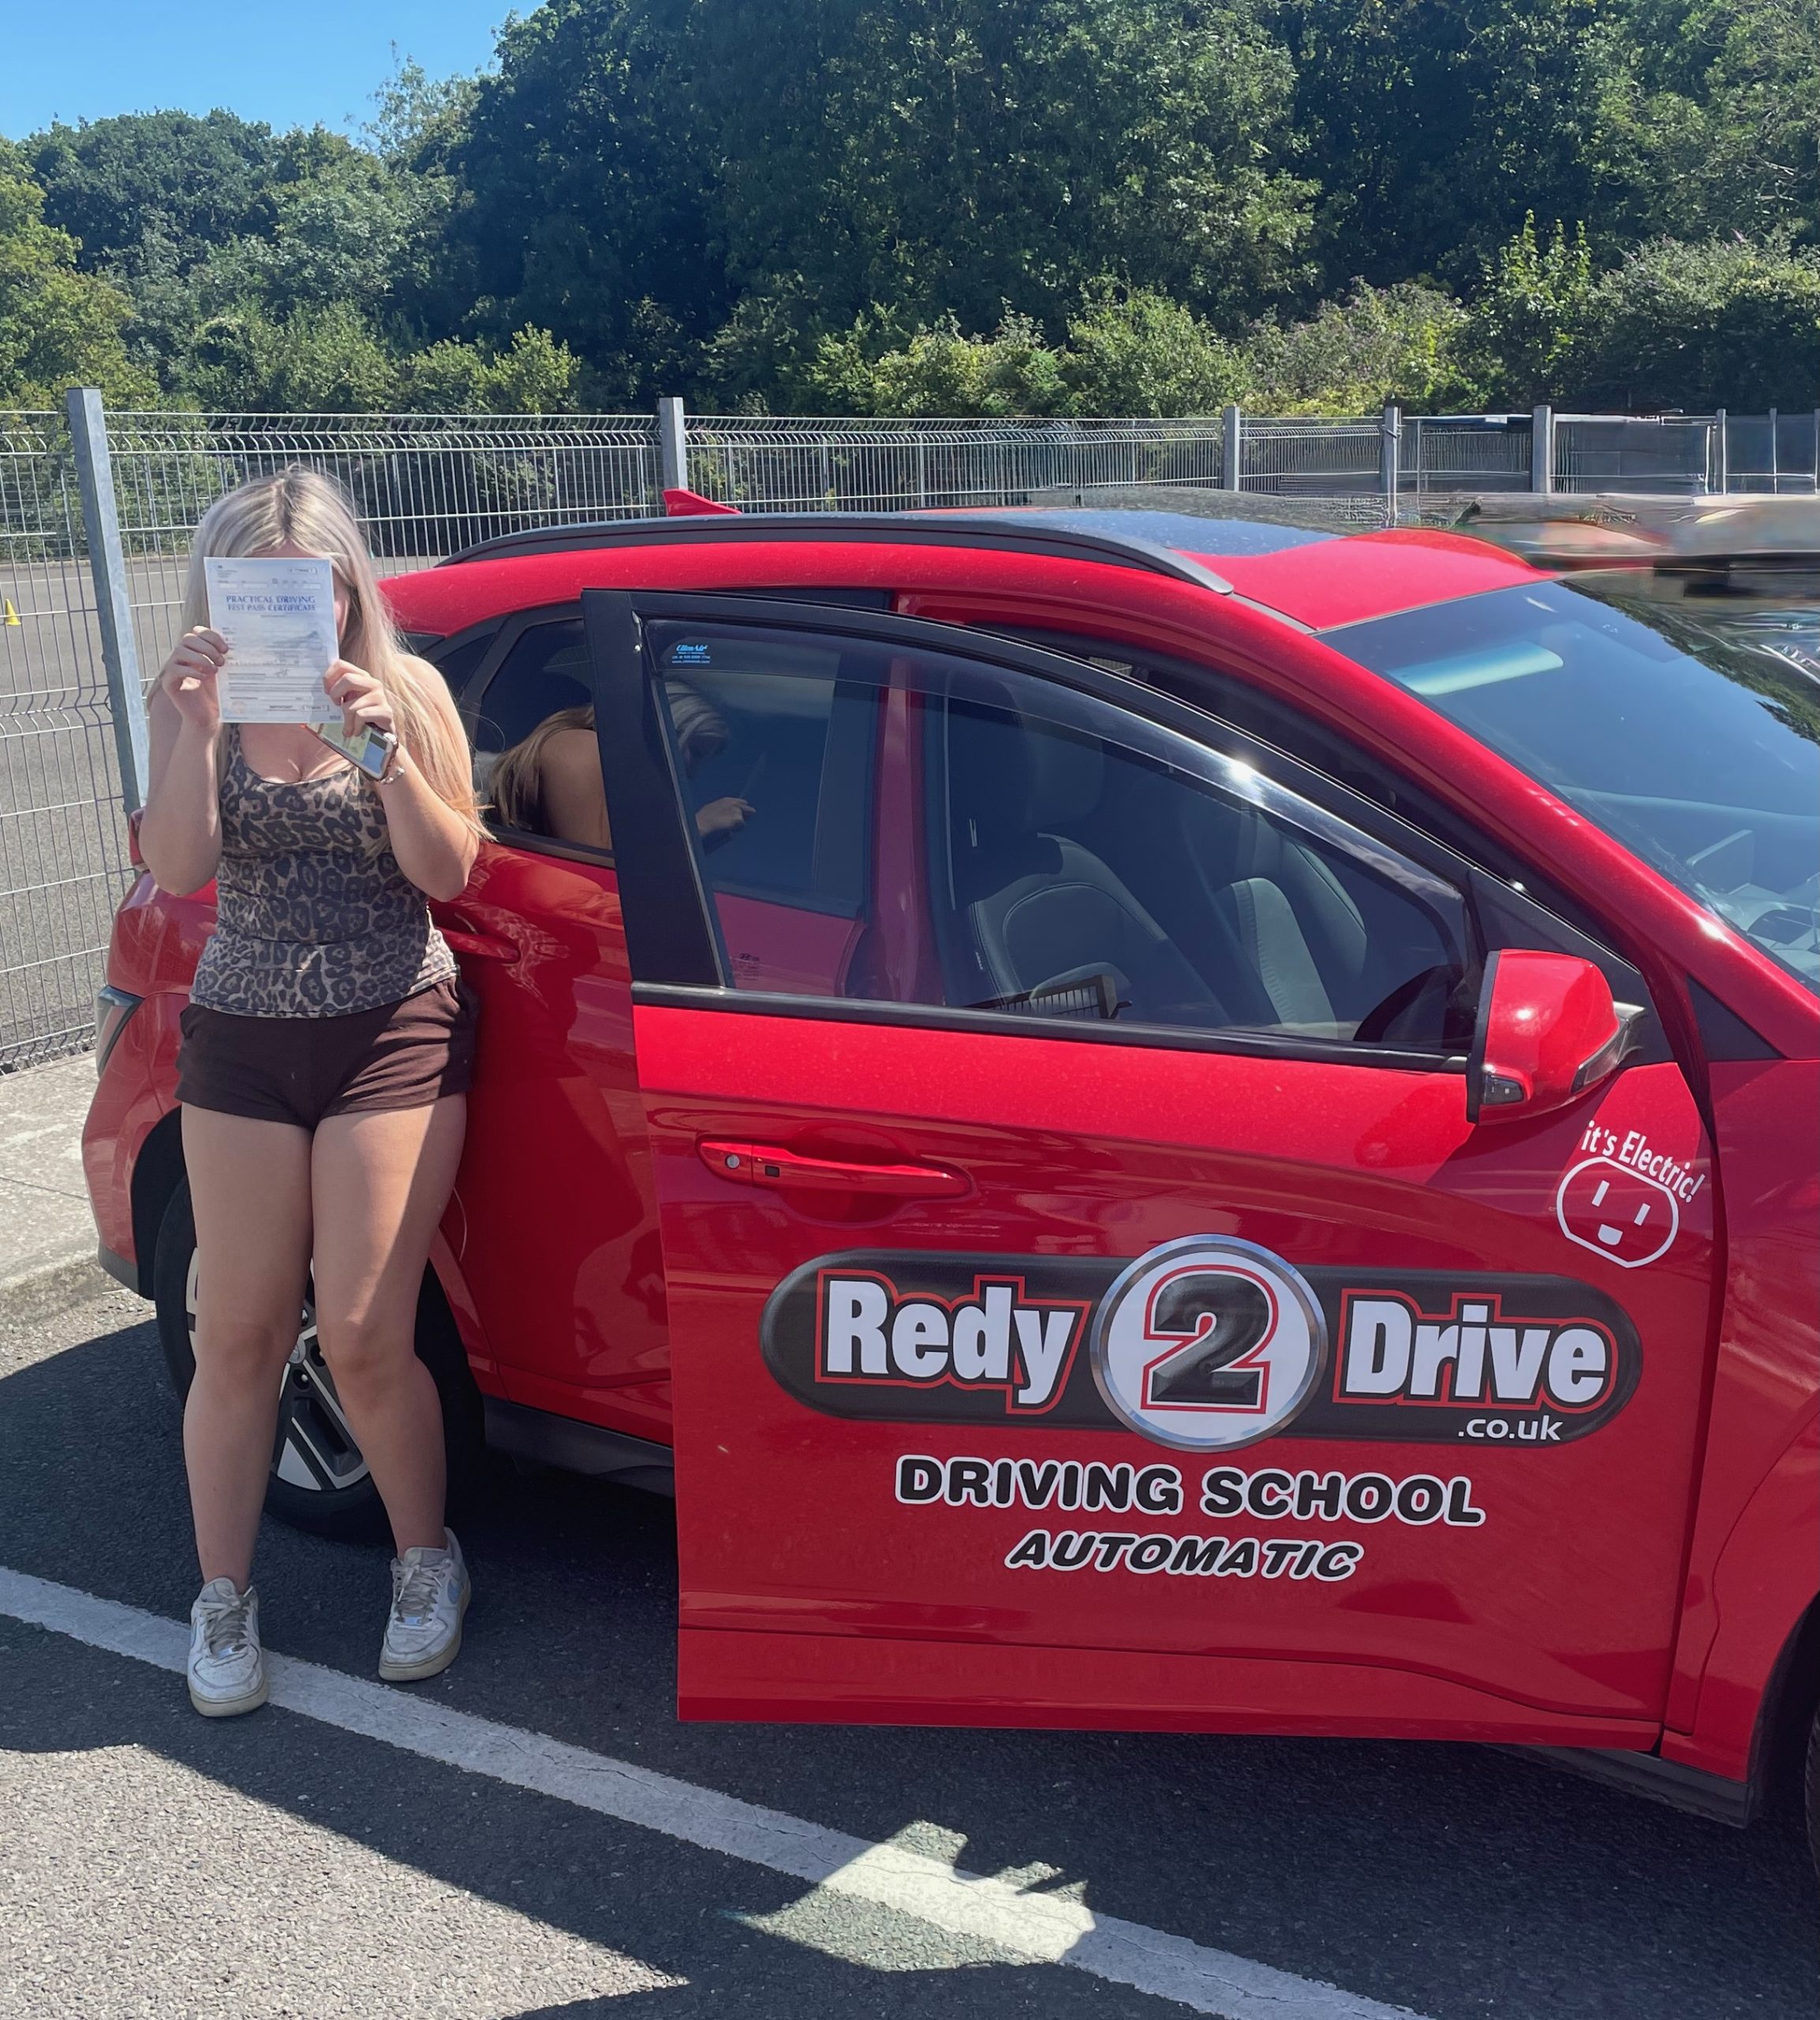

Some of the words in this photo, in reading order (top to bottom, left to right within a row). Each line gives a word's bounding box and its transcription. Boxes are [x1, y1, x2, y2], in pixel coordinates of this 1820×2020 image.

[226, 595, 273, 604] PRACTICAL
[276, 595, 316, 604] DRIVING
[1581, 1120, 1618, 1157] it's
[1618, 1130, 1706, 1203] Electric!
[824, 1277, 1078, 1408] Redy
[1143, 1266, 1277, 1412] 2
[1343, 1298, 1610, 1405] Drive
[1457, 1416, 1564, 1442] .co.uk
[895, 1454, 1184, 1516] DRIVING
[1200, 1465, 1487, 1528] SCHOOL
[1004, 1528, 1365, 1582] AUTOMATIC
